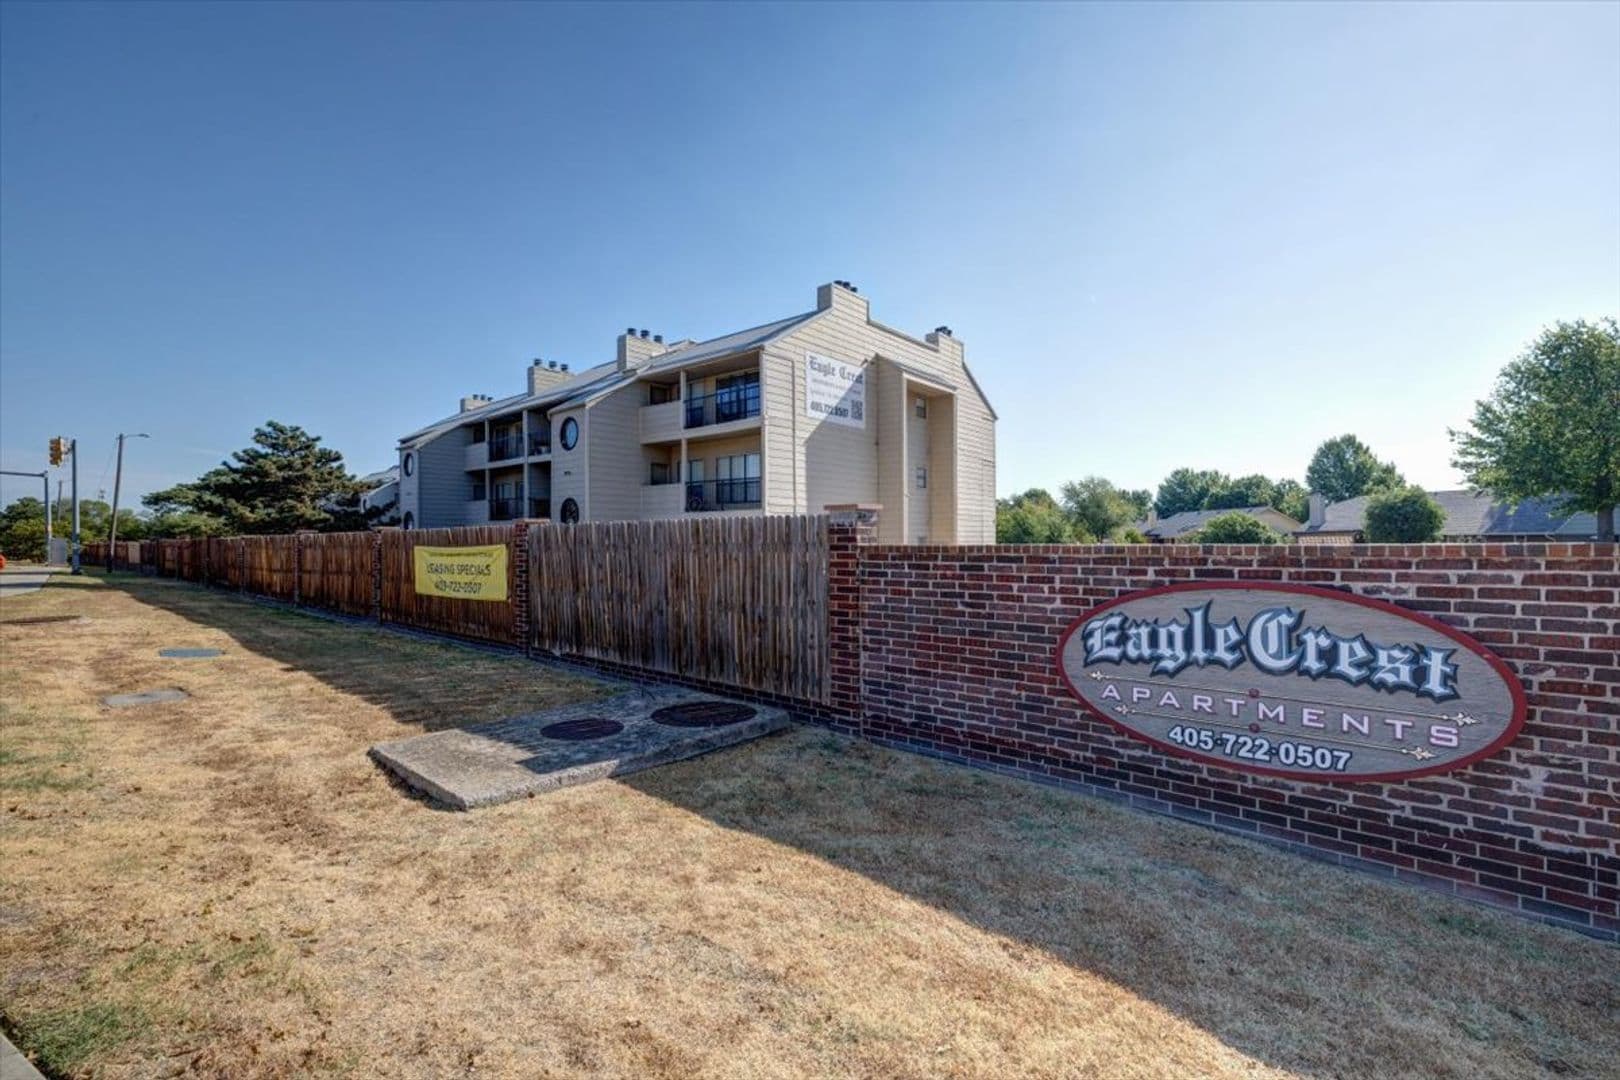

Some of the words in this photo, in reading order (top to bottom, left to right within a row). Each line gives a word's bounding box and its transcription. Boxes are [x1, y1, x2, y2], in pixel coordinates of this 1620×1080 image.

[808, 355, 836, 376] Eagle
[456, 563, 491, 576] SPECIALS
[1100, 684, 1460, 748] APARTMENTS
